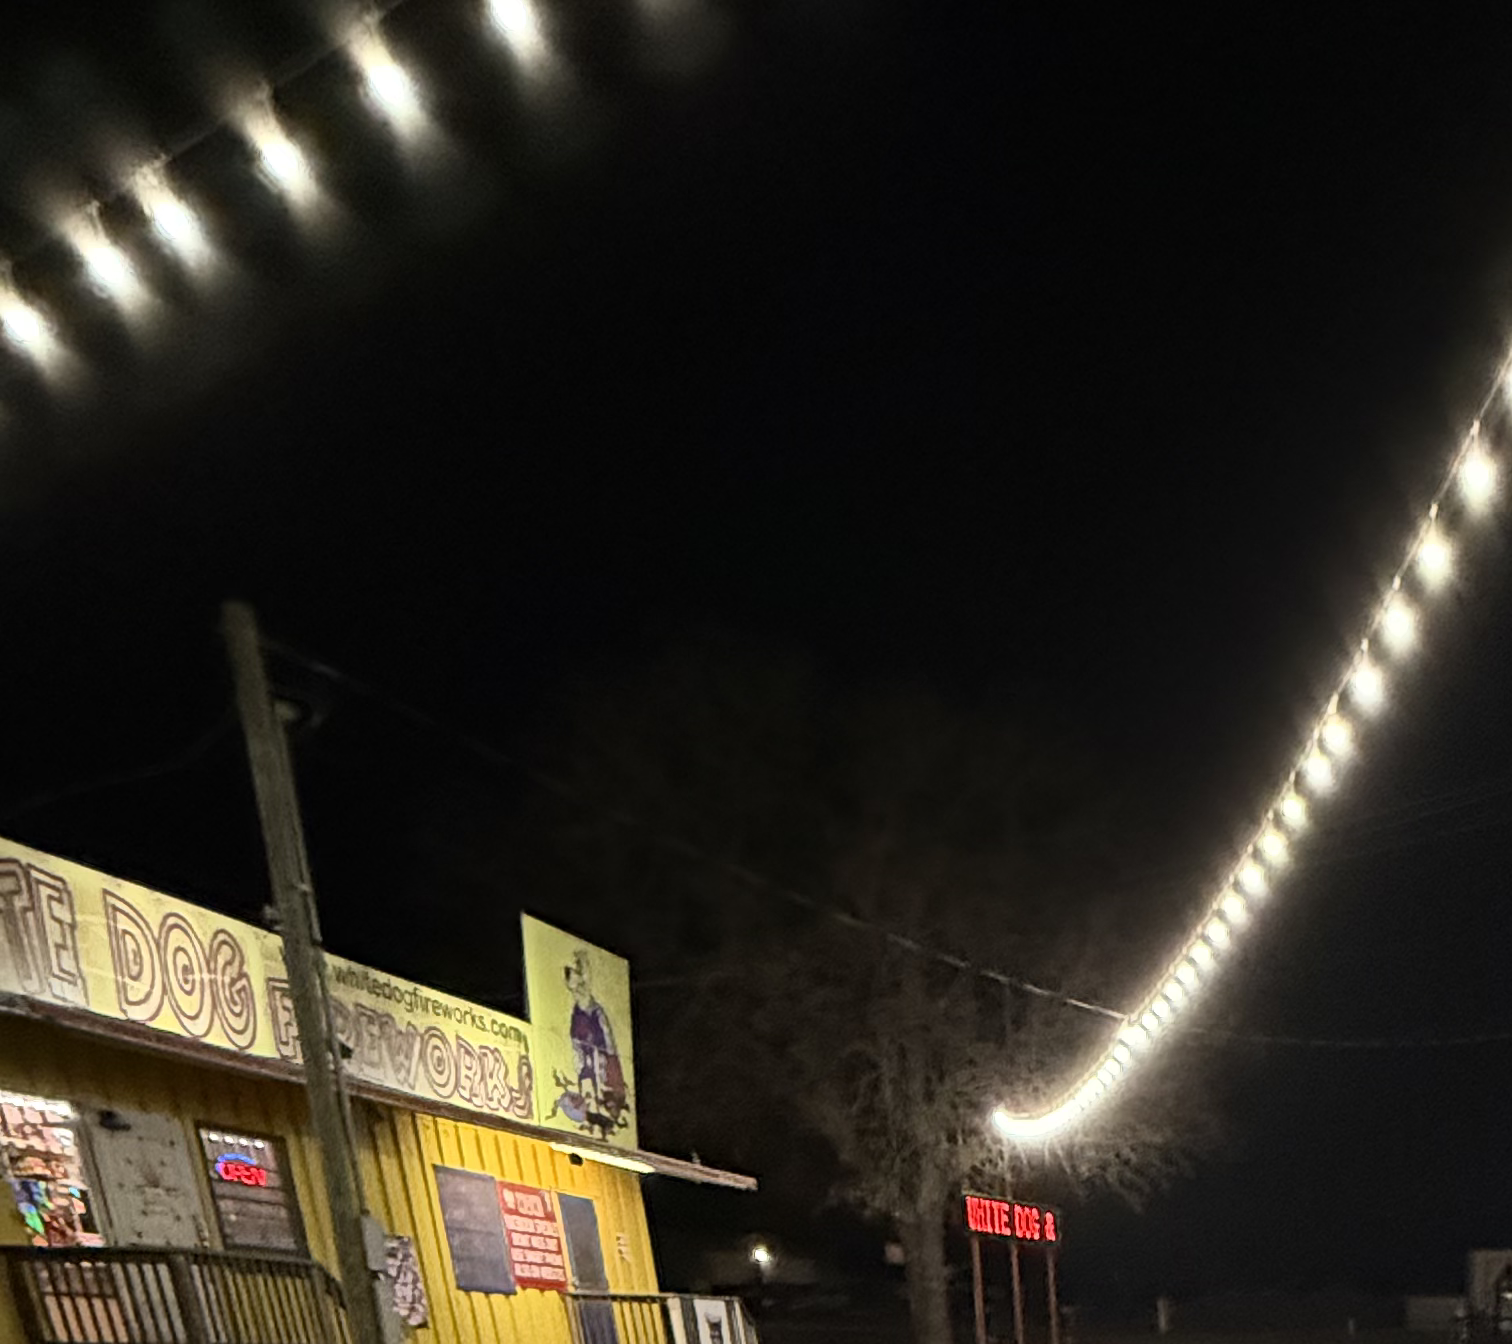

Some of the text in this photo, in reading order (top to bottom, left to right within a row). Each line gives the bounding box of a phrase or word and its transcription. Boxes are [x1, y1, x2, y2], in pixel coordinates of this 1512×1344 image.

[102, 887, 257, 1050] DOG
[267, 977, 533, 1120] FREWORKS
[220, 1162, 267, 1187] OPEN
[965, 1196, 1011, 1236] WHITE
[1014, 1203, 1040, 1240] DOG
